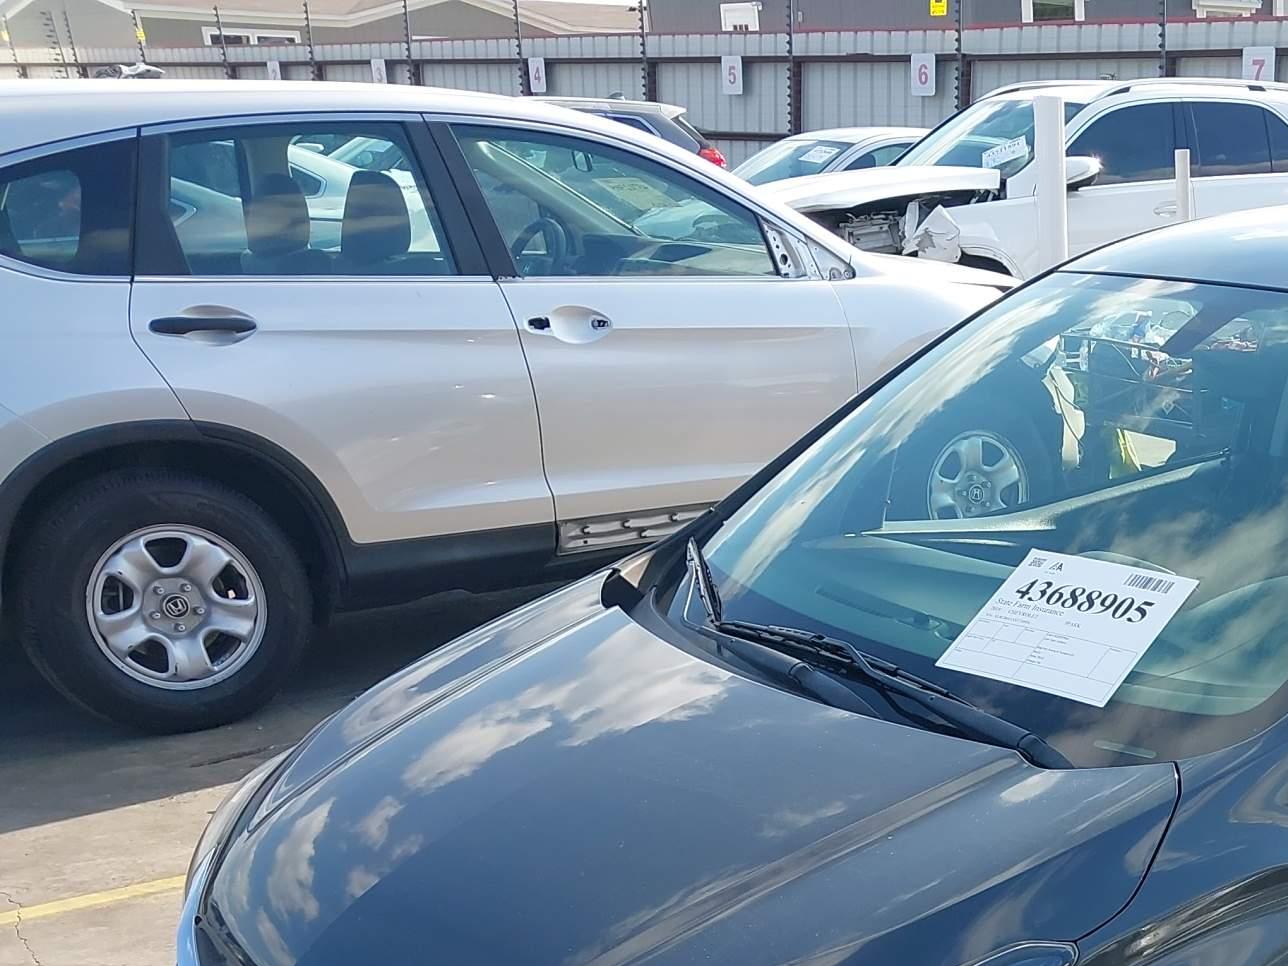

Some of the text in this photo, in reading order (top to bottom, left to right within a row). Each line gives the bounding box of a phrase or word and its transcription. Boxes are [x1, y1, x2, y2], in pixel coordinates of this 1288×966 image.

[534, 66, 542, 84] 4
[728, 66, 737, 85] 5
[918, 64, 929, 85] 6
[1252, 59, 1266, 81] 7
[1013, 600, 1031, 611] Farm
[1030, 604, 1064, 617] Insurance
[1015, 578, 1155, 623] 43688905
